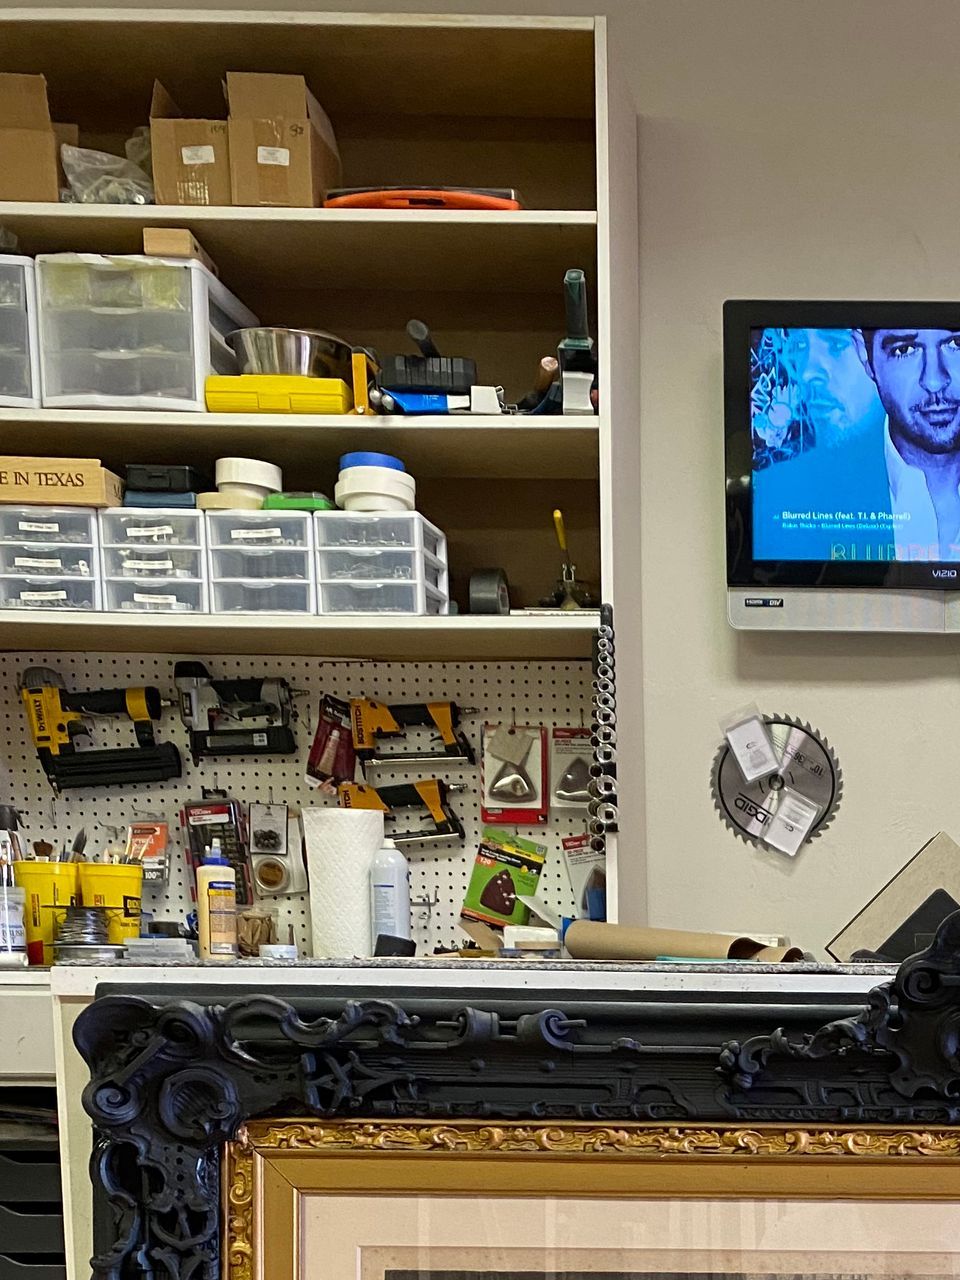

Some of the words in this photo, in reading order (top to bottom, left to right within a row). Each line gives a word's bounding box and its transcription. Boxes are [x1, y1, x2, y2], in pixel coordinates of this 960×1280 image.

[13, 471, 30, 486] IN
[34, 472, 85, 487] TEXAS
[782, 511, 811, 520] Blurred
[812, 511, 833, 520] Lines
[869, 511, 877, 520] &
[932, 569, 957, 578] VIZIO
[354, 704, 366, 745] BOSTITCH
